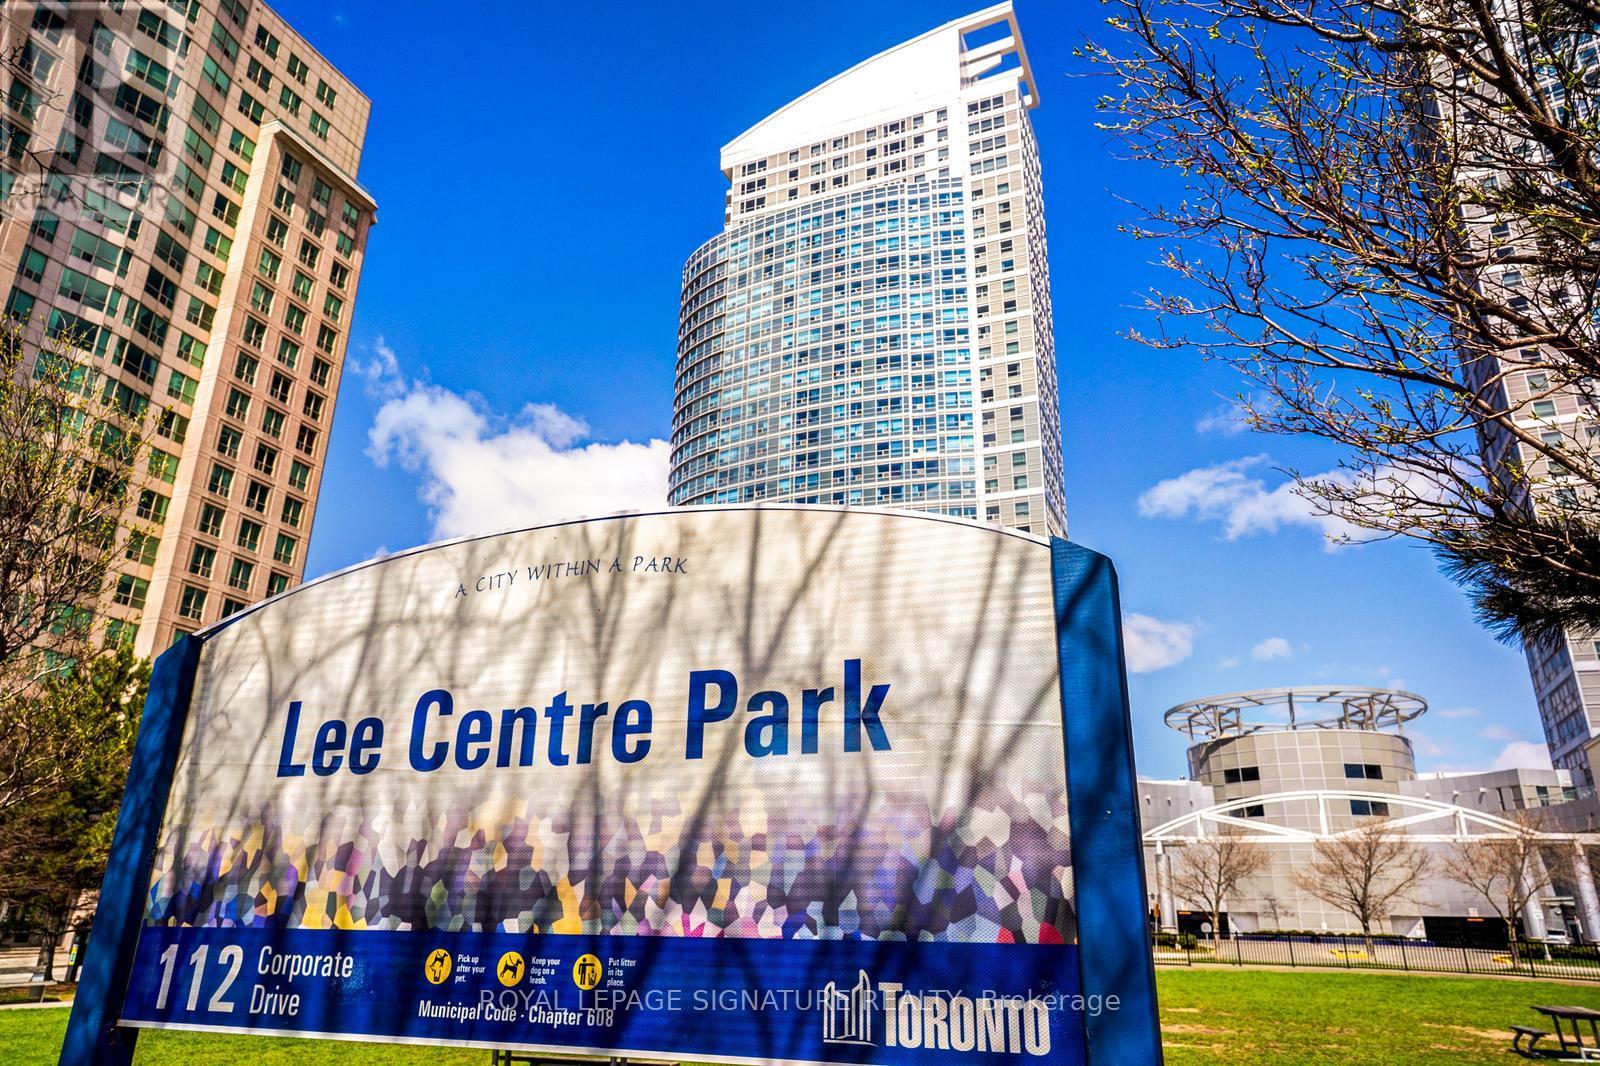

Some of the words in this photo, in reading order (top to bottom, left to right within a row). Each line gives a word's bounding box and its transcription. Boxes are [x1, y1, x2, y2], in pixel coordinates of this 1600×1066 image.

[455, 583, 467, 598] A
[475, 570, 518, 592] CITY
[527, 559, 601, 581] WITHIN
[609, 557, 622, 573] A
[632, 556, 688, 574] PARK
[277, 701, 384, 777] Lee
[408, 690, 652, 773] Centre
[686, 658, 892, 760] Park
[257, 945, 354, 982] Corporate
[457, 954, 471, 963] Pick
[472, 956, 479, 965] up
[531, 956, 546, 967] Keep
[547, 958, 561, 967] your
[608, 957, 619, 967] Put
[620, 957, 636, 967] litter
[456, 964, 470, 974] after
[471, 967, 486, 976] your
[530, 967, 541, 977] dog
[608, 968, 614, 976] in
[615, 968, 623, 977] its
[156, 944, 244, 1013] 112
[454, 974, 467, 984] pet.
[529, 976, 547, 985] leash.
[606, 977, 624, 987] place.
[249, 984, 300, 1016] Drive
[418, 999, 481, 1023] Municipal
[484, 1003, 517, 1022] Code
[528, 1006, 583, 1028] Chapter
[586, 1008, 614, 1027] 608
